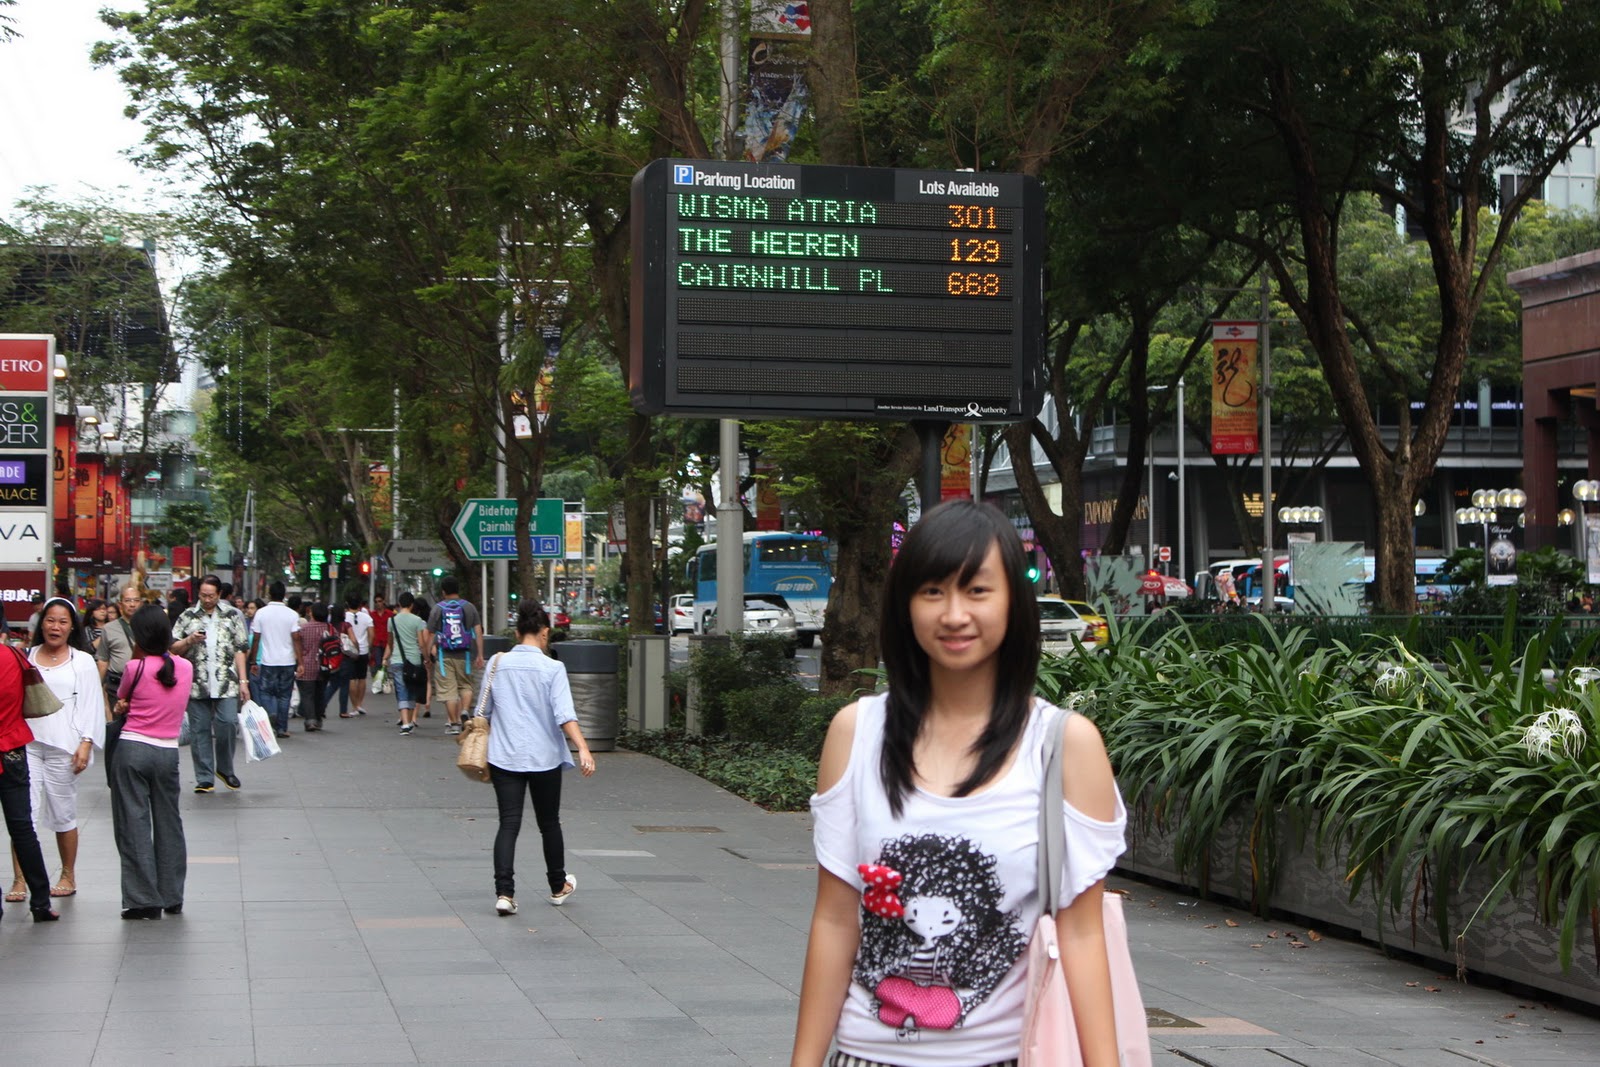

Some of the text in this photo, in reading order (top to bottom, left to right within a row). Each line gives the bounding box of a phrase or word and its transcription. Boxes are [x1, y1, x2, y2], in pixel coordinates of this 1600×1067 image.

[695, 171, 741, 190] Parking
[744, 173, 795, 190] Location
[919, 180, 999, 197] Lots Available
[678, 194, 996, 229] WISMA ATRIA 301
[678, 228, 1000, 262] THE HEEREN 129
[678, 262, 999, 296] CAIRNHILL PL 668
[0, 402, 38, 423] S &
[940, 406, 966, 414] Transport
[980, 406, 1007, 415] Authority
[479, 505, 519, 516] Bidefor
[479, 521, 515, 532] Cairnhi
[483, 540, 504, 552] CTE
